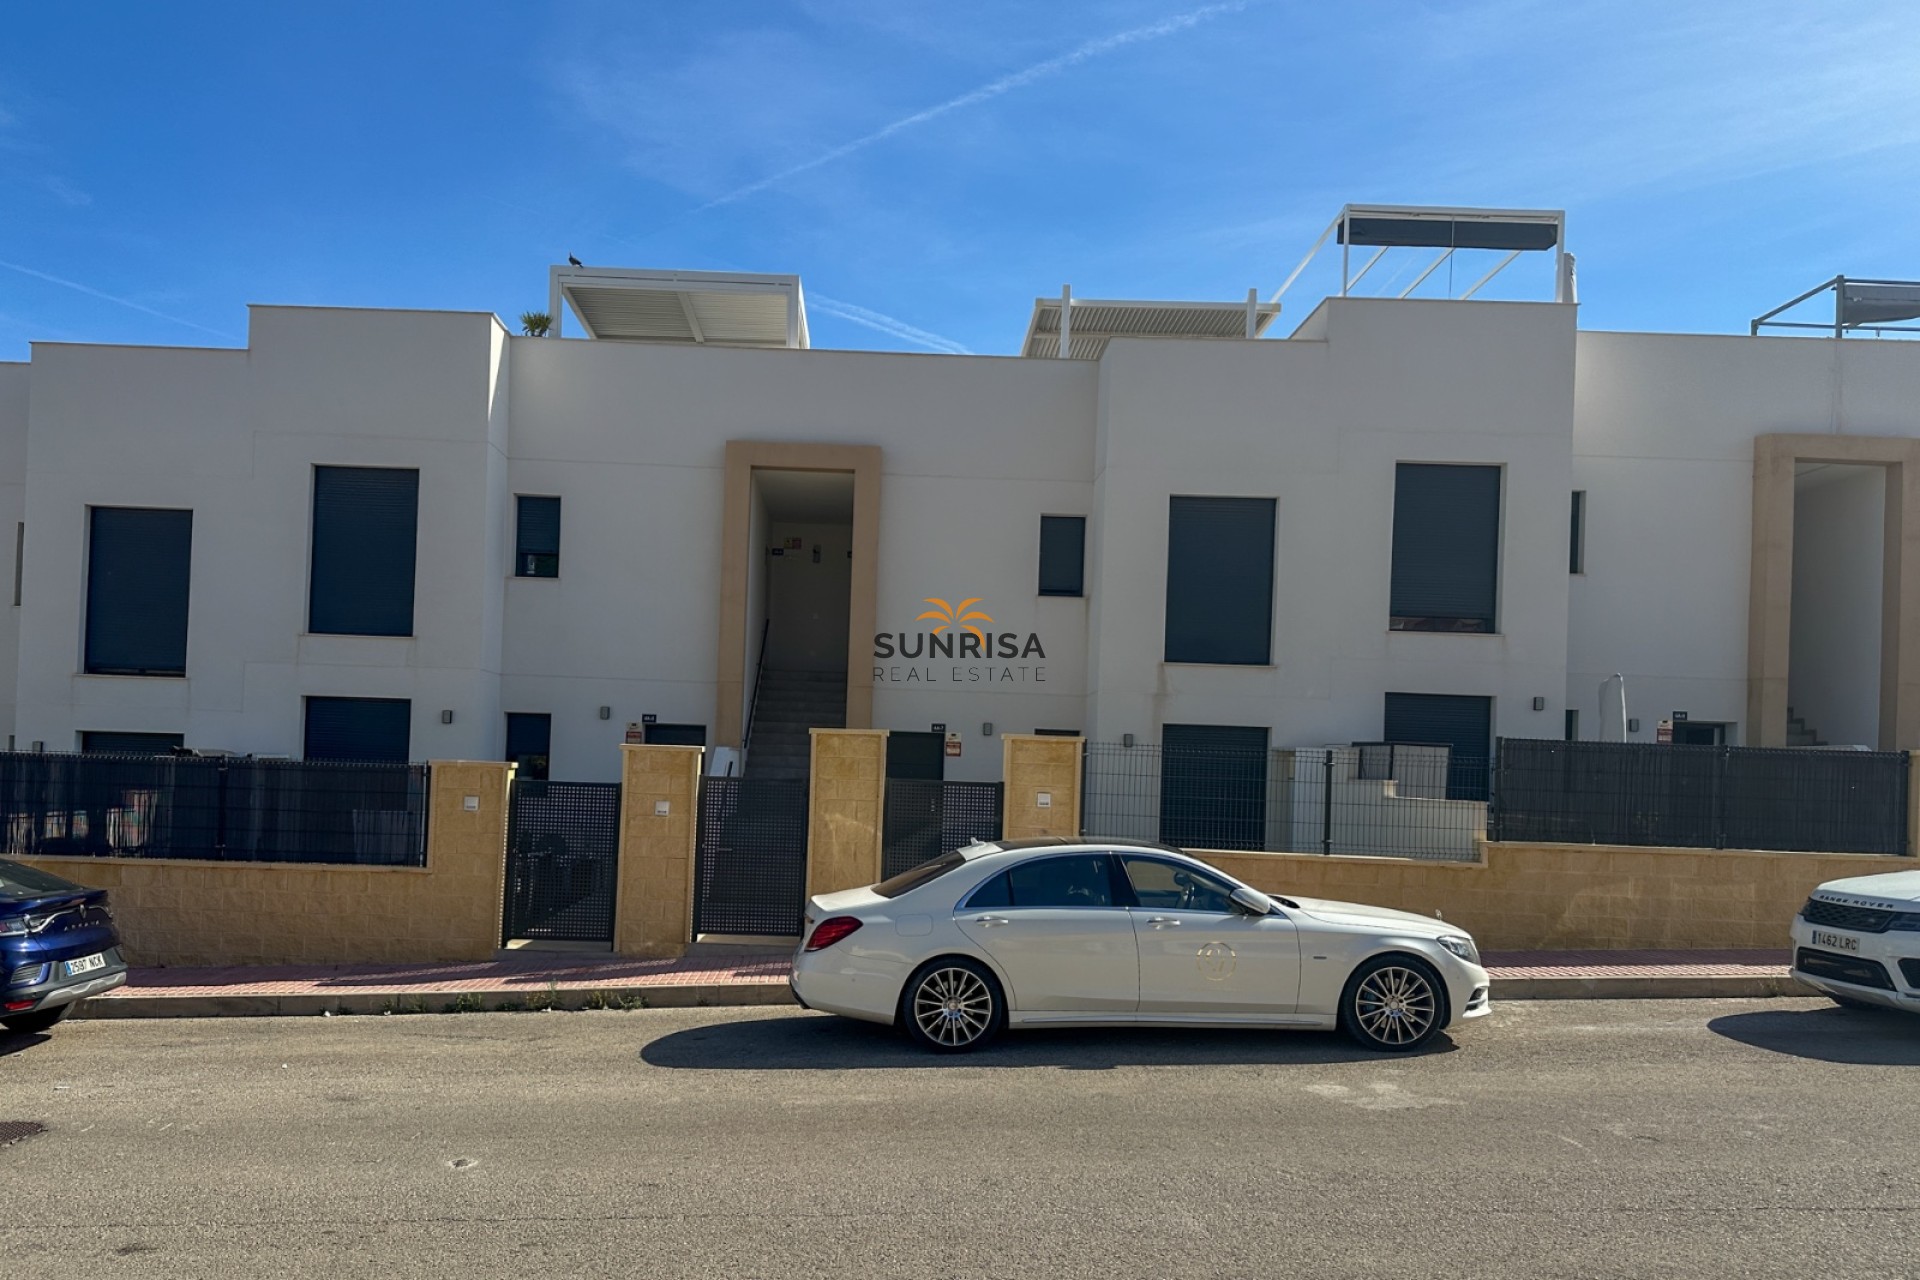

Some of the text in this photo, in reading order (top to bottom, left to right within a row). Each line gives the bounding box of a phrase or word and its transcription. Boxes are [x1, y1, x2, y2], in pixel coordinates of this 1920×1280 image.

[1819, 895, 1894, 909] RANGE ROVER
[1818, 933, 1857, 950] 1462 LRC
[71, 959, 87, 974] 2597
